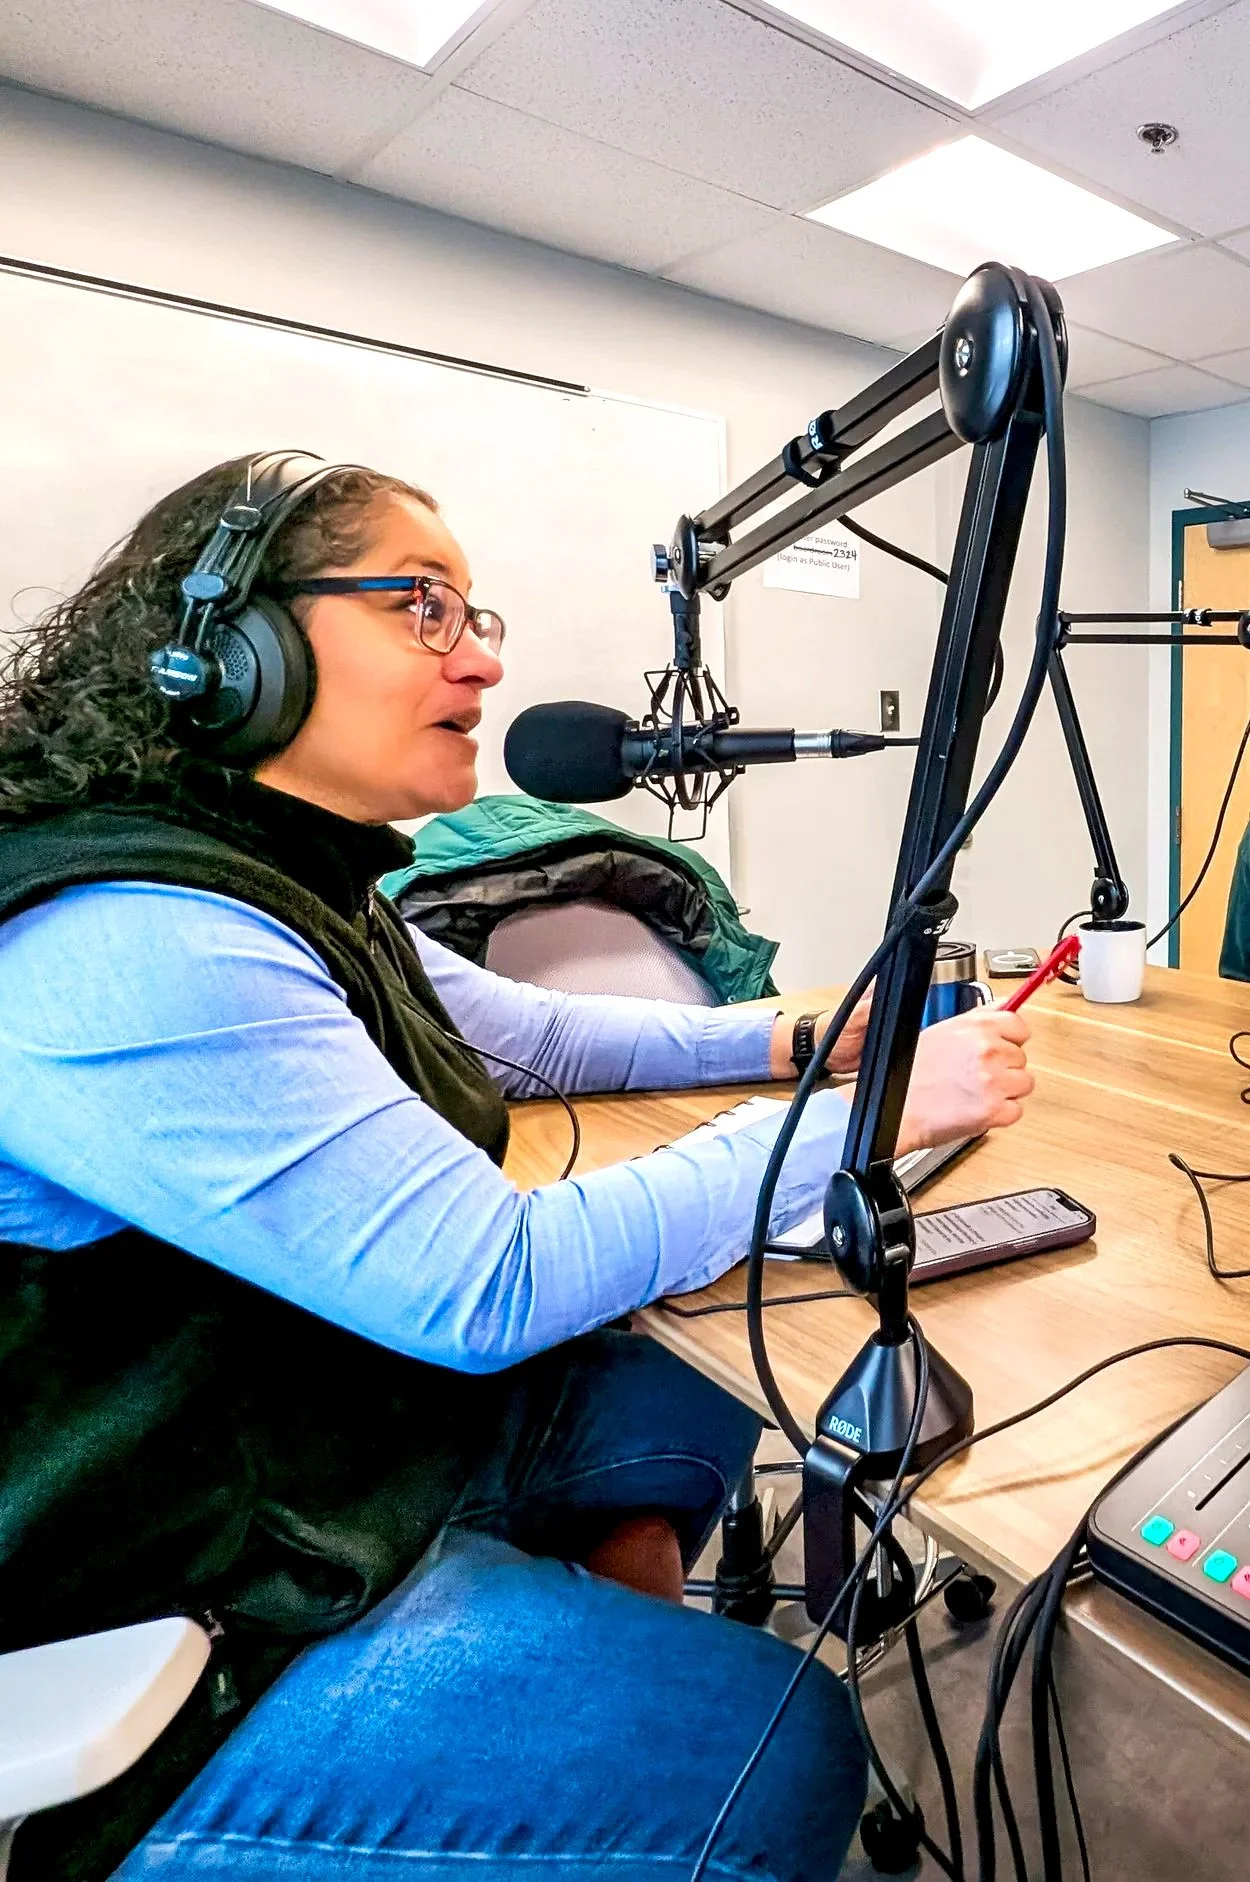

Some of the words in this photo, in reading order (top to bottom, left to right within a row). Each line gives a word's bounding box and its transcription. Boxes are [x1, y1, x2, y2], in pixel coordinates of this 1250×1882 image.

[833, 548, 857, 561] 2324
[809, 558, 830, 568] Public
[829, 1415, 863, 1443] RØDE
